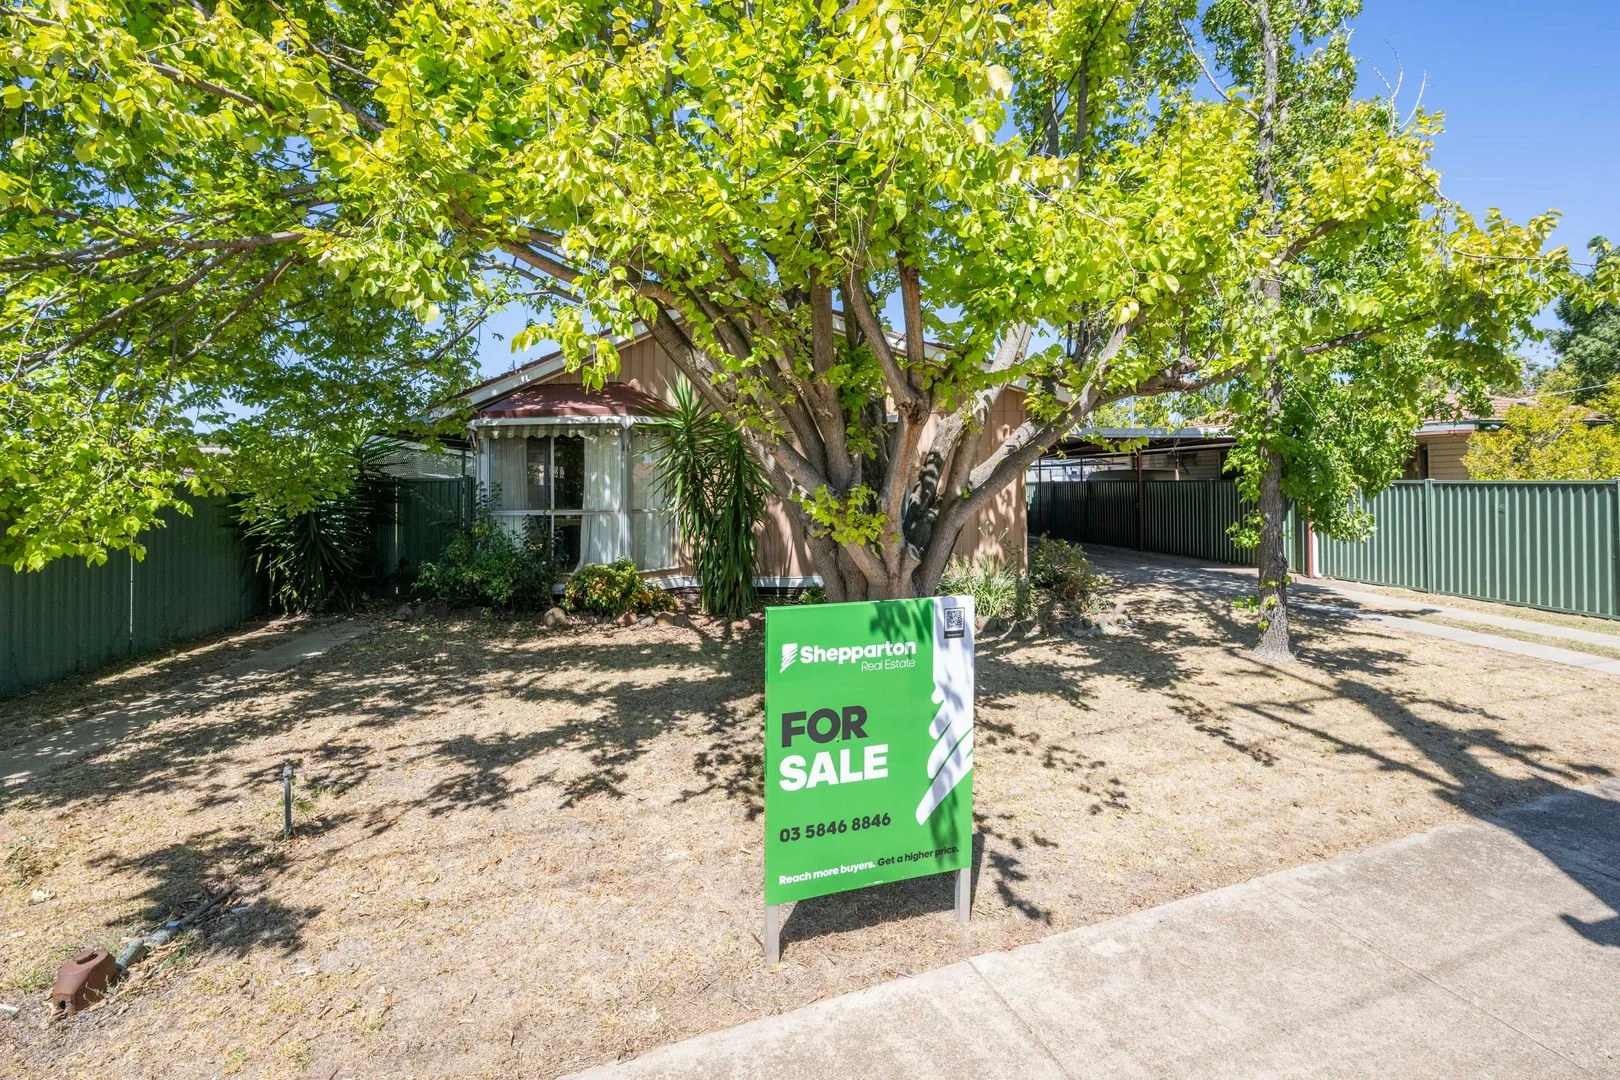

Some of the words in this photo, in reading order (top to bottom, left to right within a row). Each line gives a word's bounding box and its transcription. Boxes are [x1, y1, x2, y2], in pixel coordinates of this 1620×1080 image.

[800, 641, 916, 664] Shepparton
[861, 660, 883, 672] Real
[884, 658, 916, 670] Estate
[781, 705, 868, 748] FOR
[779, 744, 888, 792] SALE
[779, 828, 800, 843] 03
[805, 819, 848, 839] 5846
[851, 813, 891, 832] 8846
[779, 872, 812, 885] Reach
[813, 867, 839, 879] more
[840, 861, 876, 873] buyers.
[877, 856, 895, 866] Get
[904, 850, 933, 862] higher
[934, 846, 959, 858] price.
